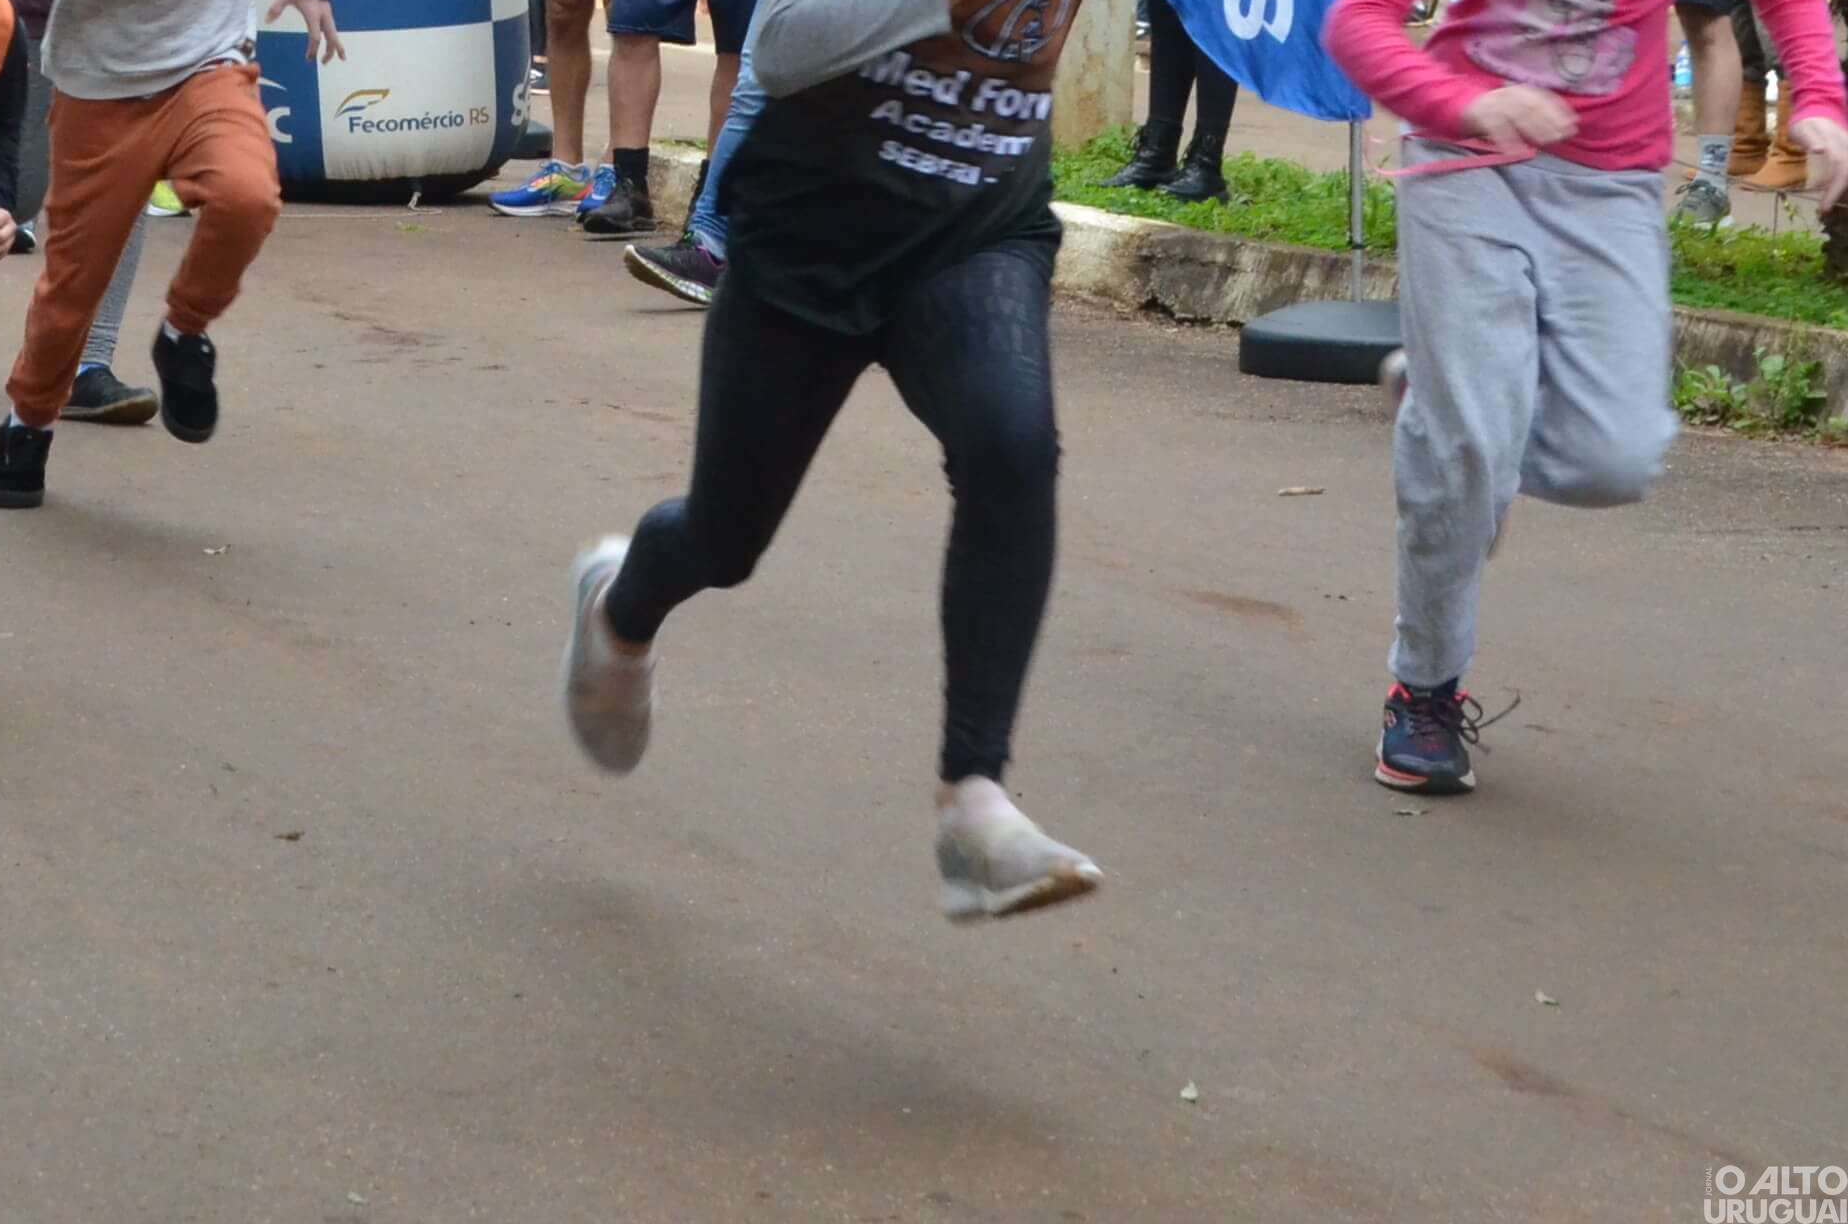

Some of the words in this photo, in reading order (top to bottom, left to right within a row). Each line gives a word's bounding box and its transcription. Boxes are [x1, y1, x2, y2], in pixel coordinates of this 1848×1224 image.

[858, 50, 972, 106] Med
[348, 111, 464, 134] Fecomércio
[469, 107, 490, 125] RS
